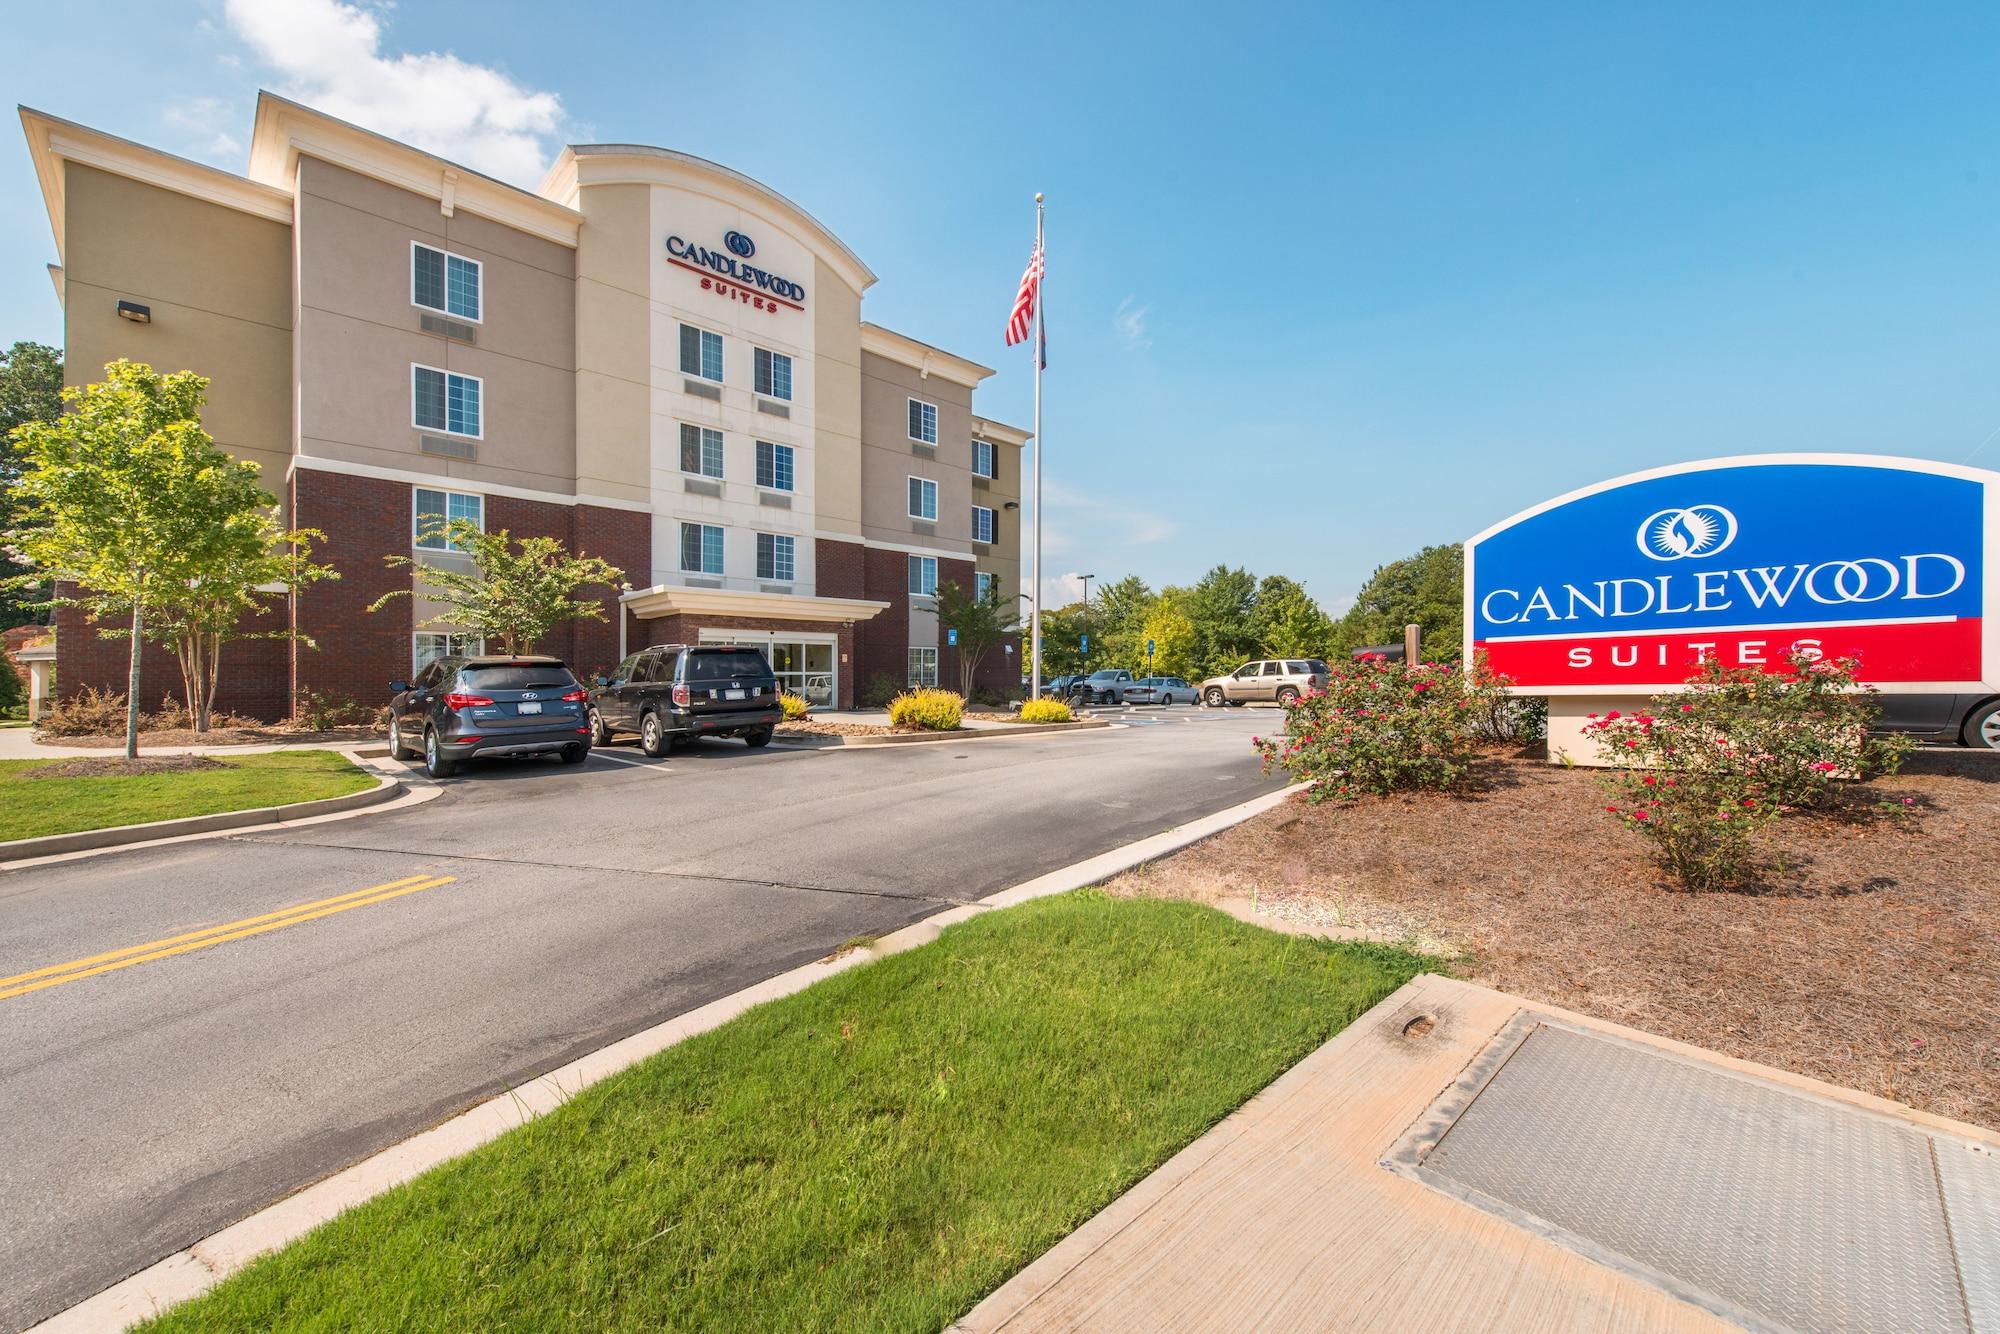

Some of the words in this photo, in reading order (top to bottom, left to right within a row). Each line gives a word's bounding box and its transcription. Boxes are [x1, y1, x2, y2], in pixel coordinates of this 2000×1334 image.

[666, 235, 805, 302] CANDLEWOOD
[701, 277, 777, 314] SUITES
[1481, 553, 1966, 625] CANDLEWOOD
[1567, 638, 1824, 668] SUITES
